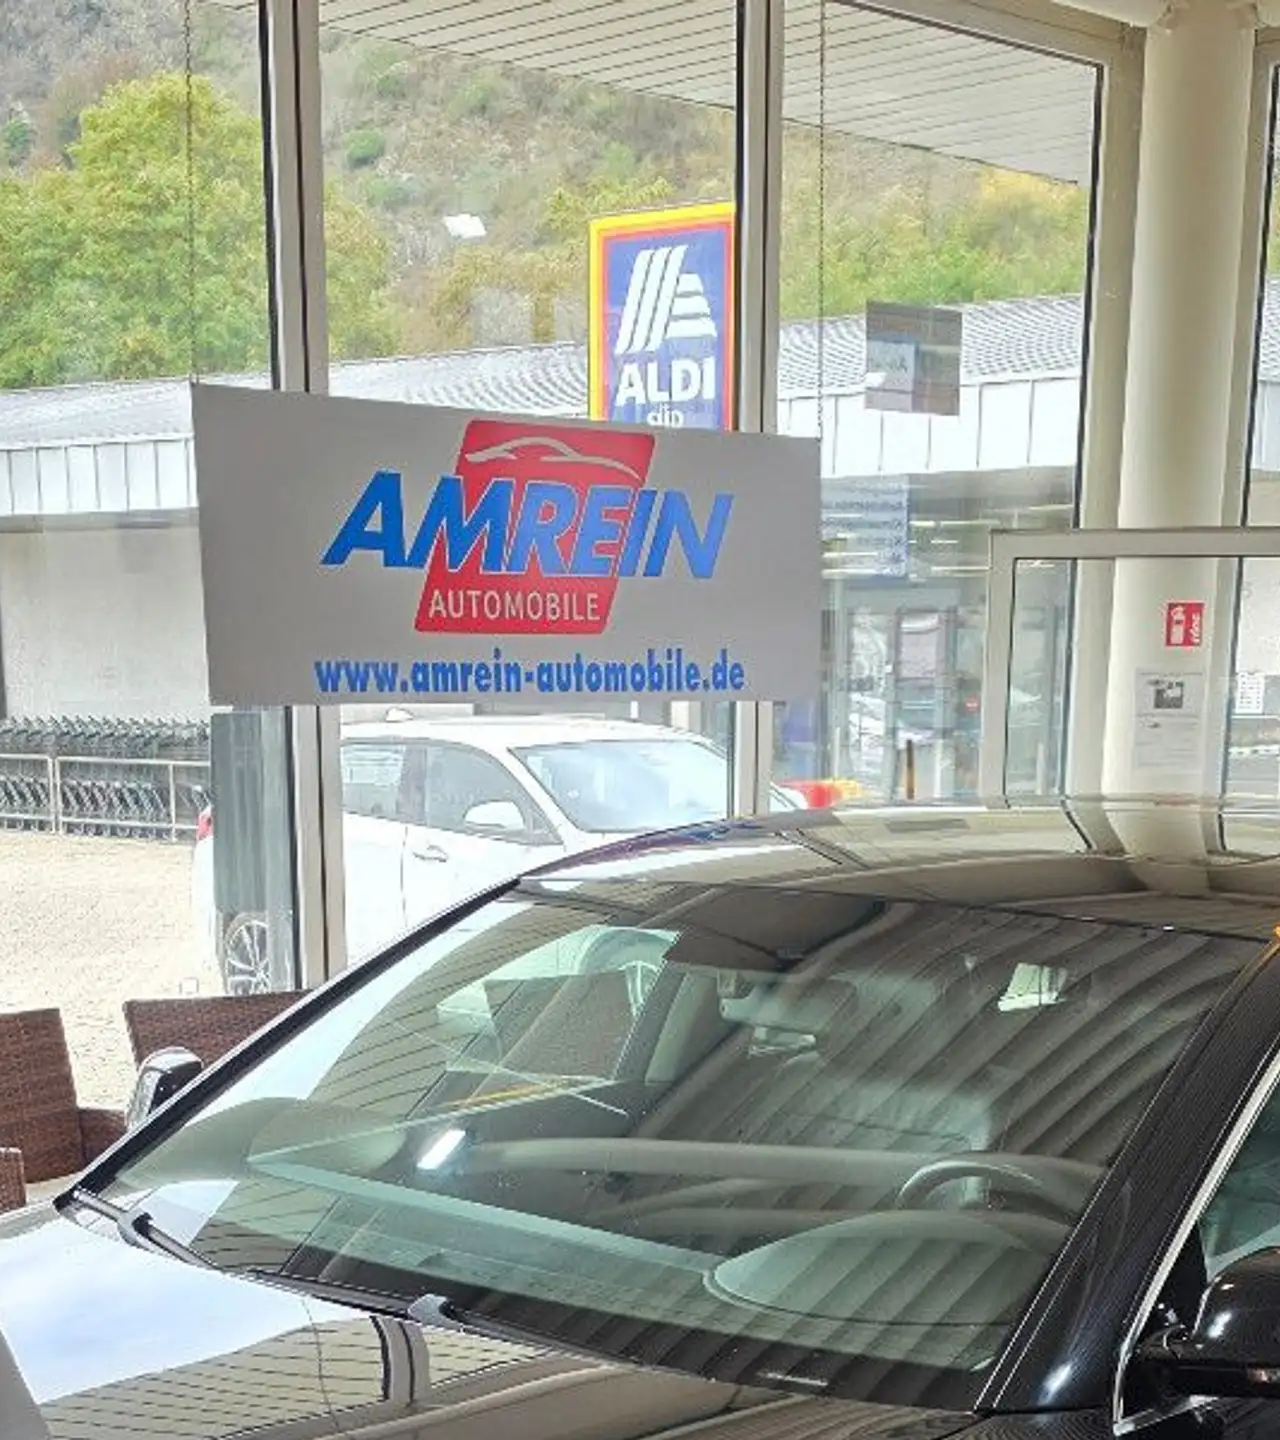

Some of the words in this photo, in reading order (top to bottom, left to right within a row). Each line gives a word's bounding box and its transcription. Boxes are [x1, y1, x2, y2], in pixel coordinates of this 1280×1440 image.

[615, 356, 716, 406] ALDI
[321, 467, 734, 579] AMREIN
[428, 589, 601, 621] AUTOMOBILE
[314, 647, 745, 694] www.amrein-automobile.de
